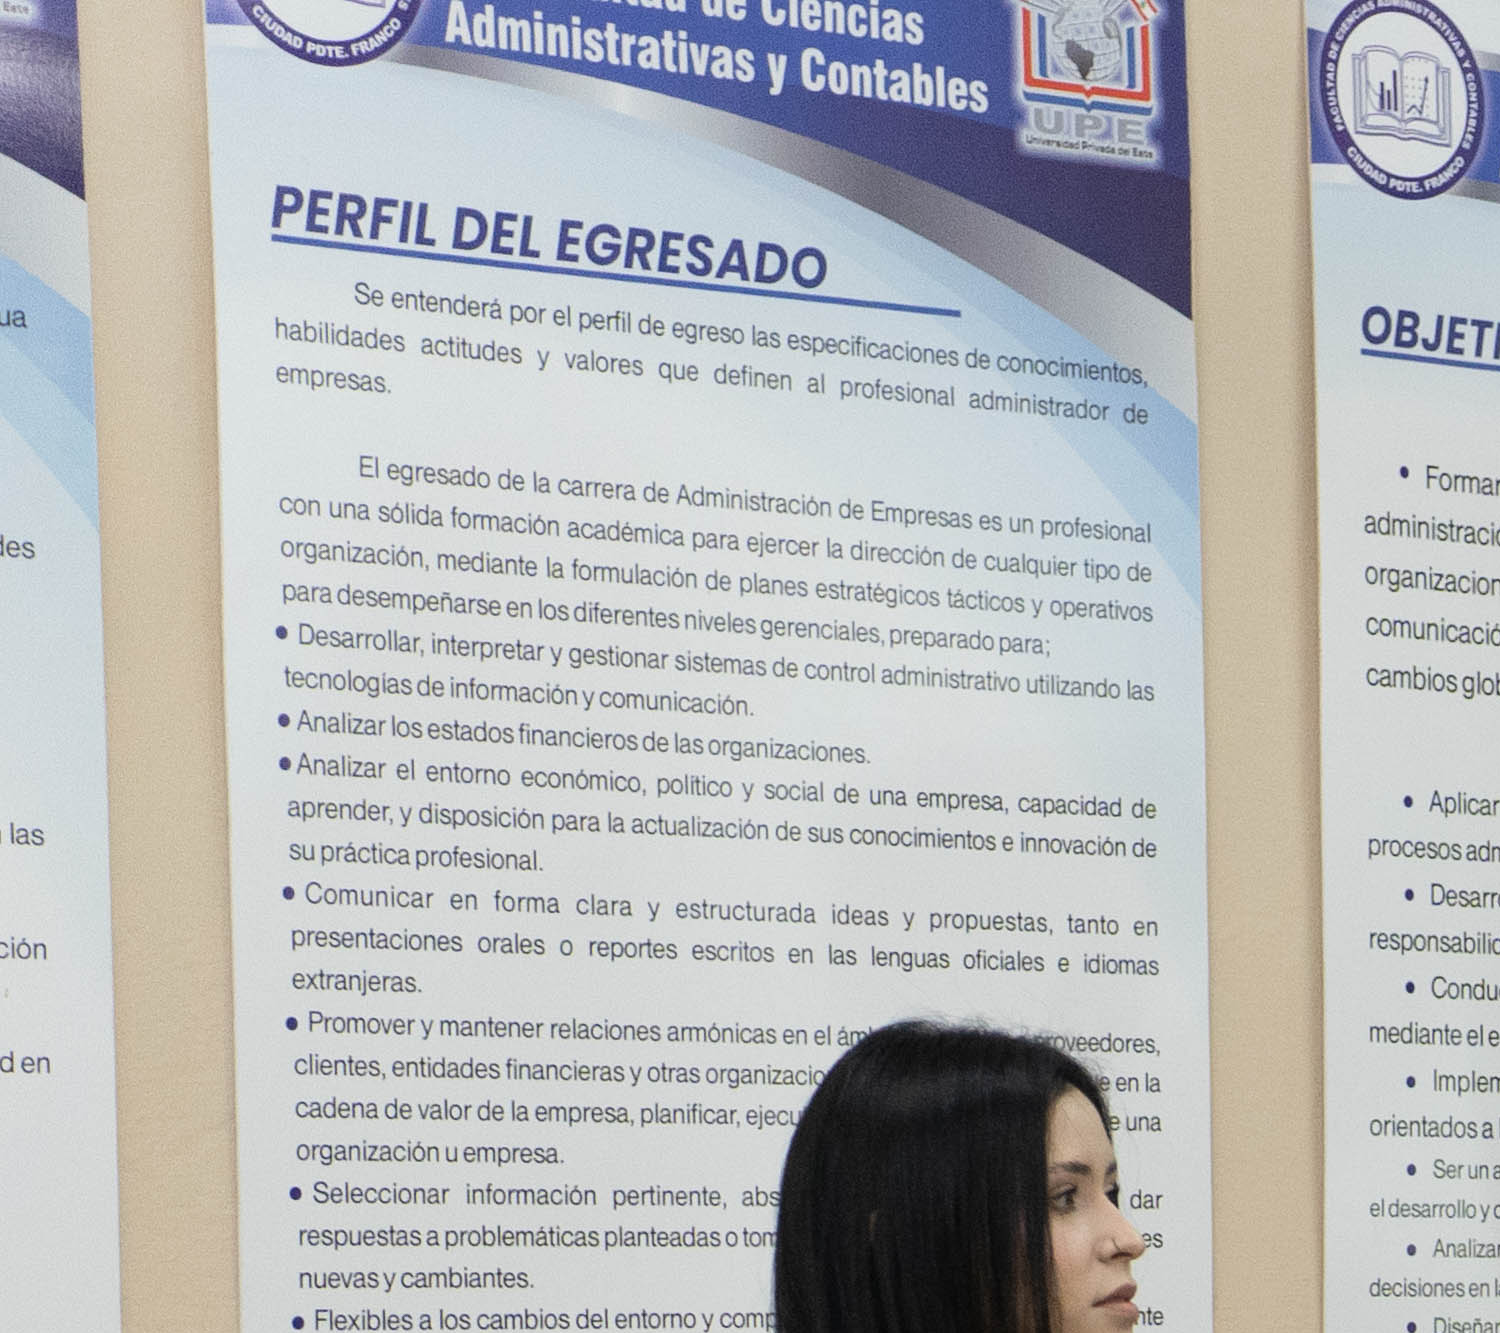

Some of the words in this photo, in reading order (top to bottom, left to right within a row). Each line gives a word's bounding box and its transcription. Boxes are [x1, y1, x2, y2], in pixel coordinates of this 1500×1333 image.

[253, 5, 302, 48] CIUDAD
[351, 18, 400, 55] FRANCO
[445, 0, 755, 82] Administrativas
[767, 53, 787, 95] y
[801, 48, 988, 113] Contables
[1034, 107, 1147, 145] UPE
[272, 185, 436, 246] PERFIL
[452, 207, 540, 258] DEL
[557, 220, 827, 289] EGRESADO
[10, 822, 44, 846] las
[305, 881, 434, 908] Comunicar
[450, 893, 477, 910] en
[494, 890, 560, 914] forma
[576, 894, 632, 916] clara
[648, 902, 660, 922] y
[676, 899, 816, 924] estructurada
[832, 904, 889, 926] ideas
[903, 912, 915, 931] y
[930, 912, 1053, 935] propuestas,
[1067, 914, 1119, 935] tanto
[1133, 920, 1158, 936] en
[21, 1056, 50, 1074] en
